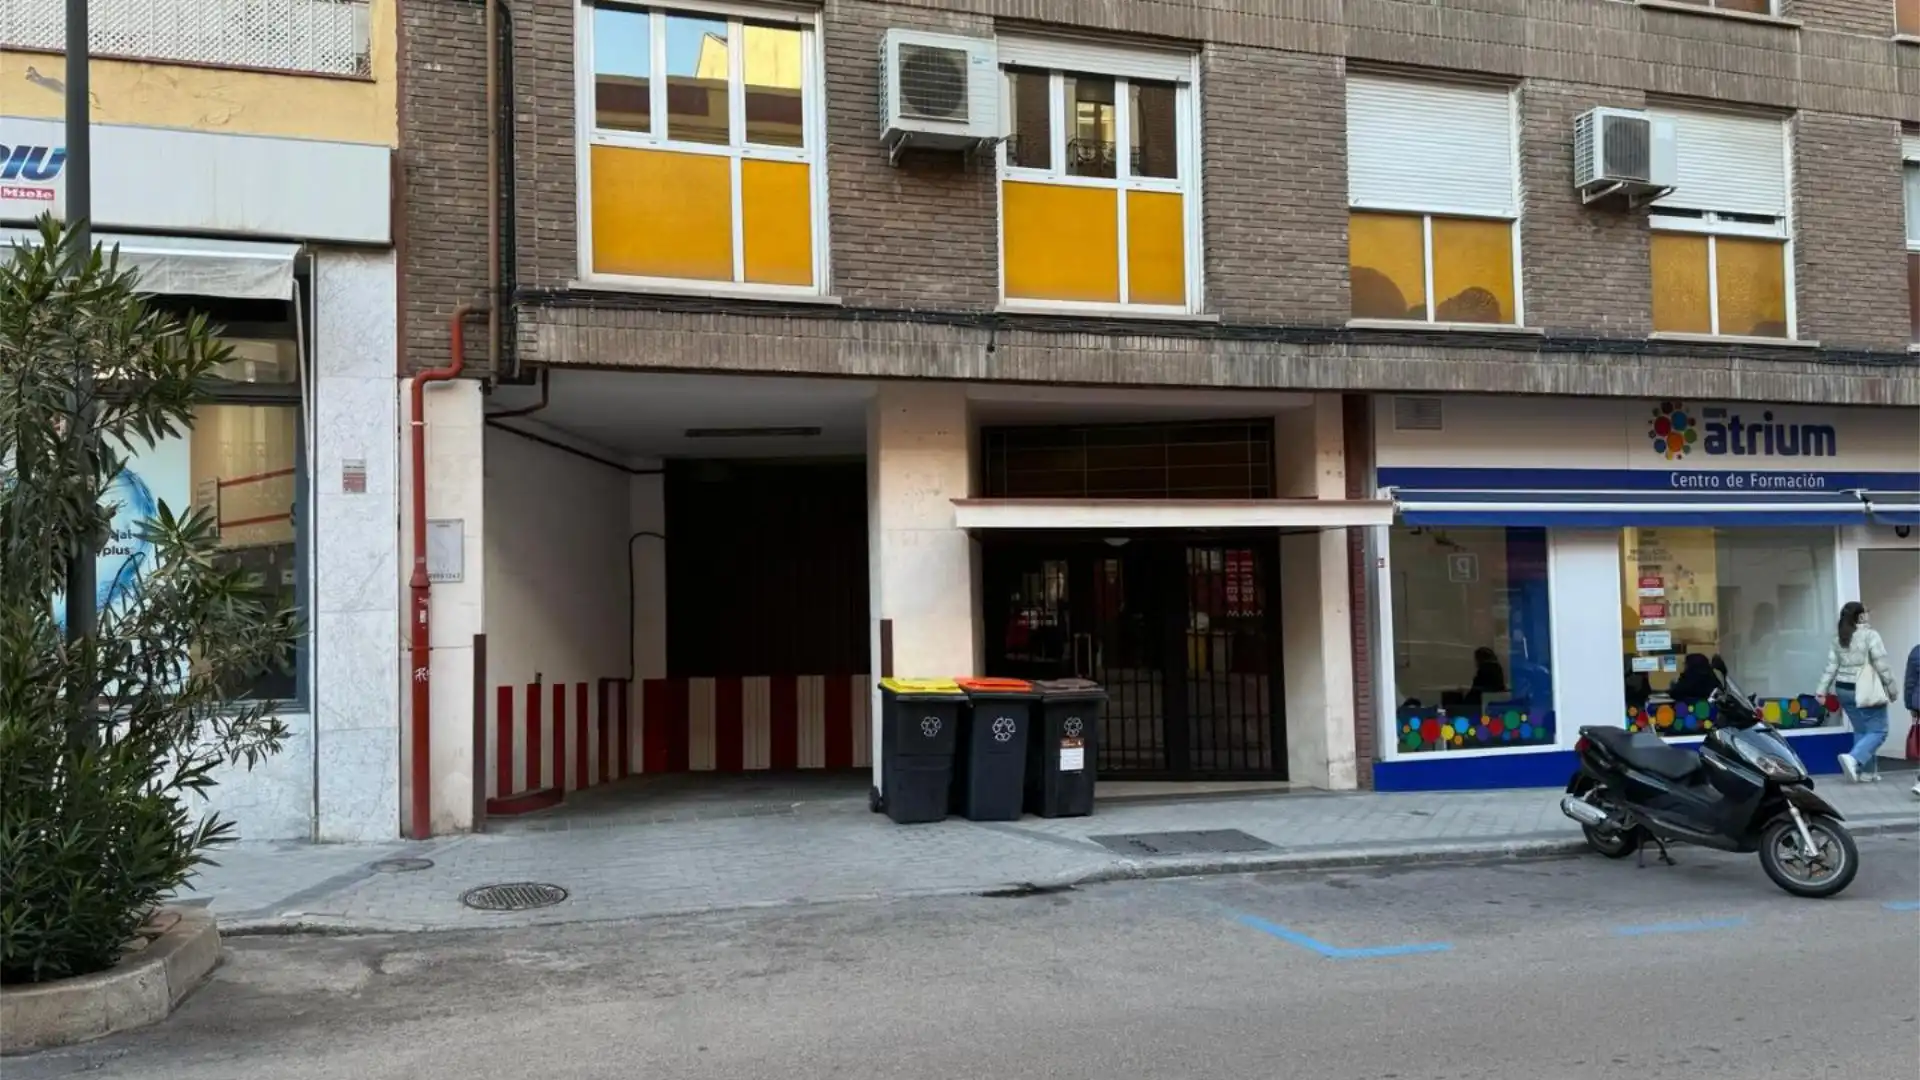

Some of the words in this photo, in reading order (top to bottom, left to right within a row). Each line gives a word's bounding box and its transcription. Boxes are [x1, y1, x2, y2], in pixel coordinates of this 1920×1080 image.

[3, 188, 53, 199] Miele
[1671, 472, 1719, 488] Centro
[1726, 473, 1744, 488] de
[1751, 473, 1825, 489] Formación
